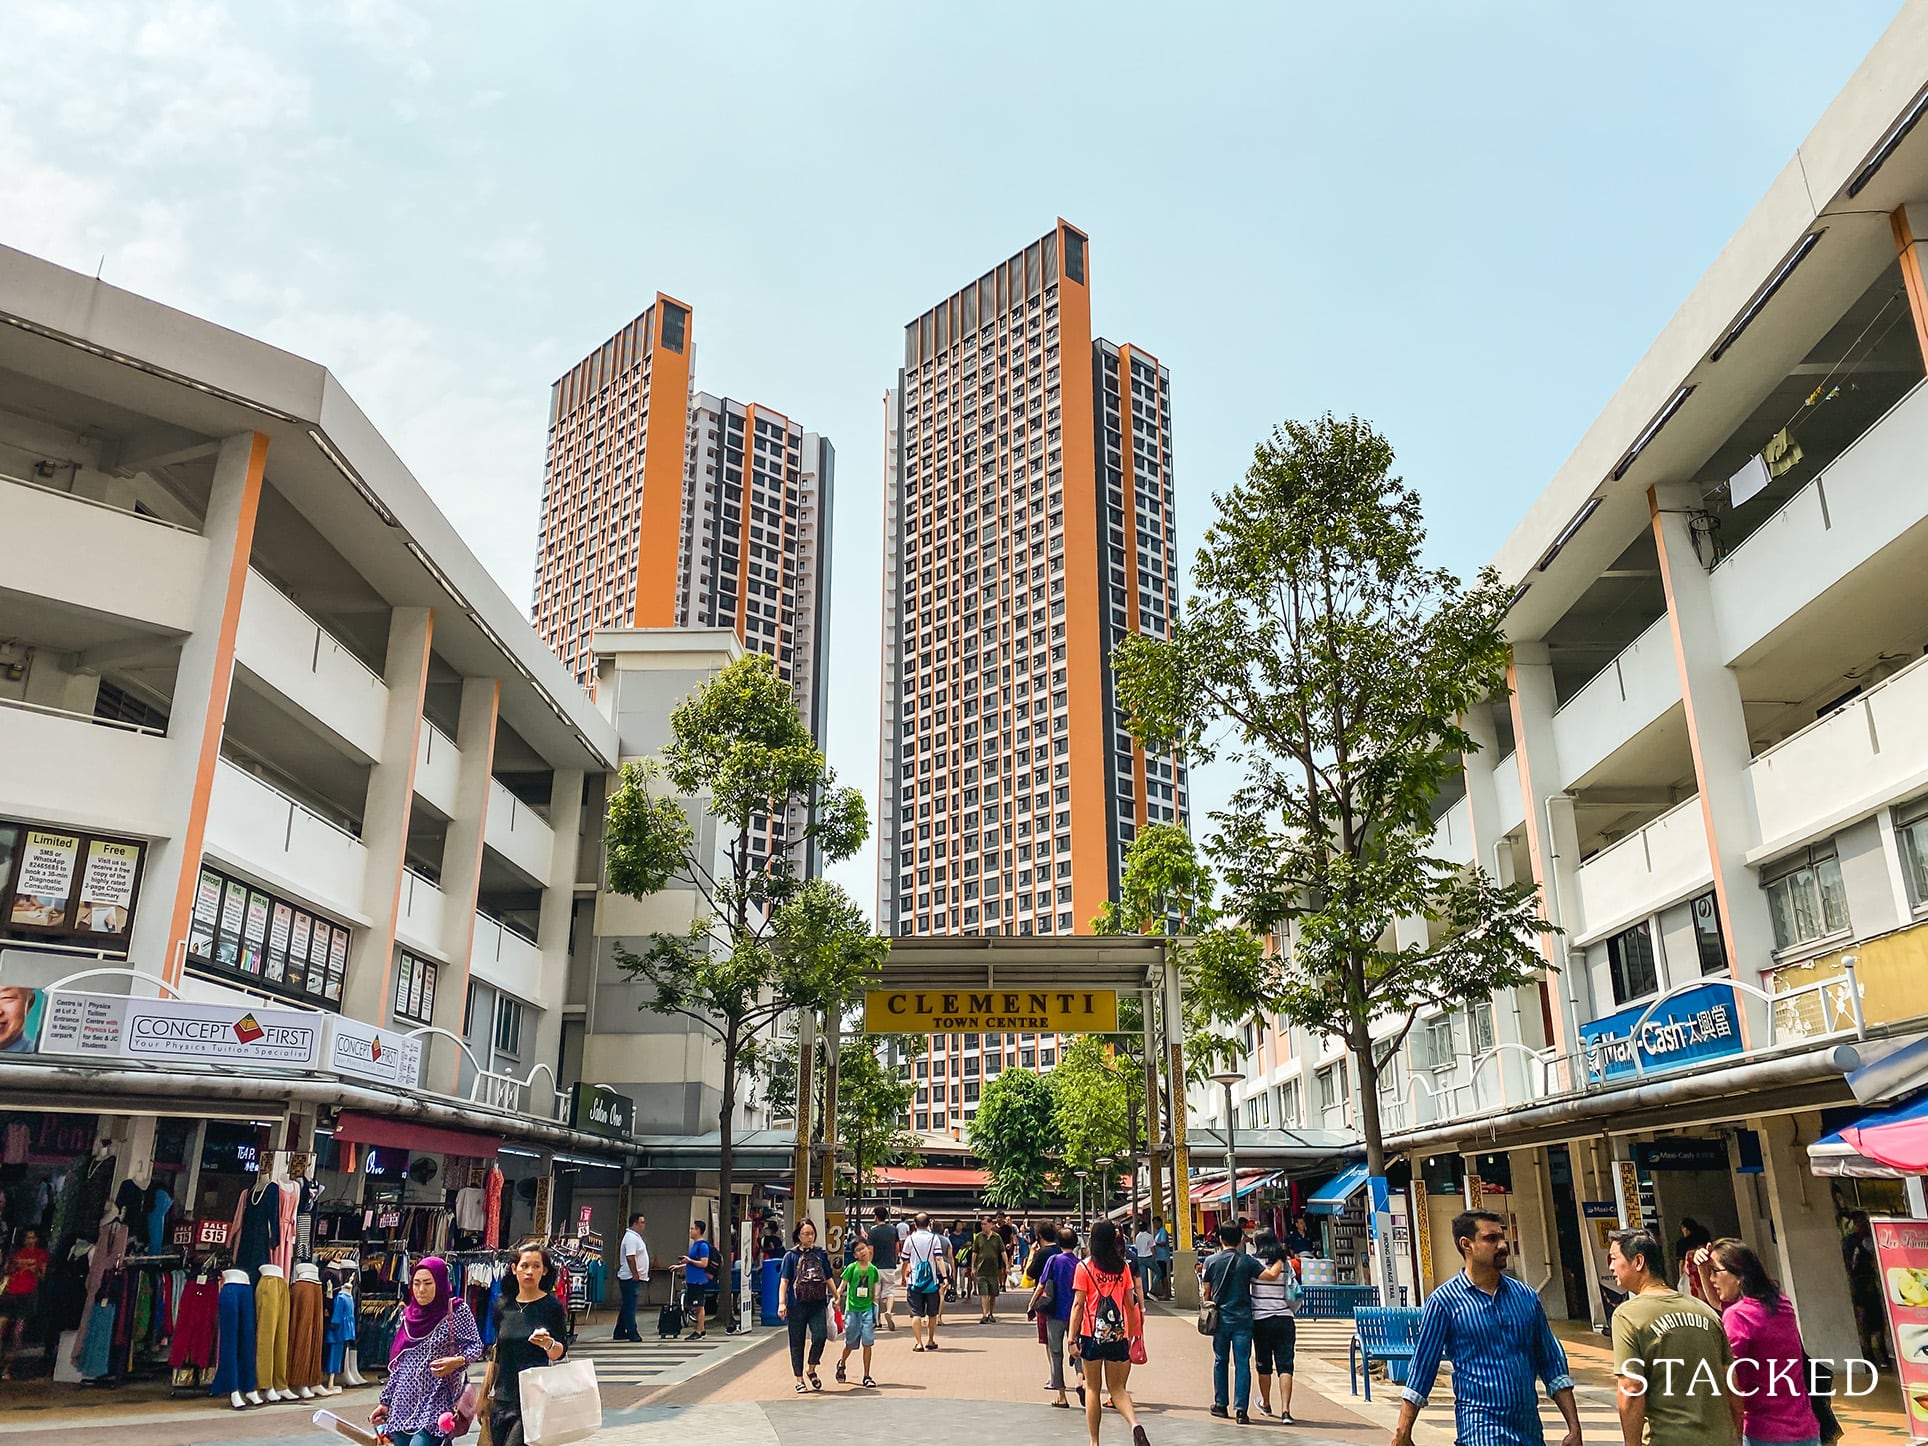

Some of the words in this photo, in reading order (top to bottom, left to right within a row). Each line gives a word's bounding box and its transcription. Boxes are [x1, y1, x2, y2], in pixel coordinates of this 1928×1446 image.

[33, 834, 72, 848] Limited
[103, 844, 126, 855] Free
[28, 876, 62, 885] Diagnostic
[93, 871, 108, 880] copy
[24, 882, 64, 892] Consultation
[106, 885, 130, 894] Chapter
[91, 890, 120, 900] Summary
[888, 994, 1094, 1014] CLEMENTI
[58, 1024, 77, 1032] facing
[933, 1017, 979, 1028] TOWN
[986, 1017, 1048, 1028] CENTRE
[137, 1018, 230, 1040] CONCEPT
[266, 1028, 309, 1046] FIRST
[134, 1039, 159, 1048] Your
[165, 1041, 206, 1051] Physics
[212, 1044, 249, 1053] Tuition
[255, 1047, 307, 1058] Specialist
[337, 1036, 370, 1057] CONCEPT
[381, 1048, 397, 1065] FIRST
[590, 1097, 608, 1124] Salon
[609, 1103, 622, 1127] One
[203, 1222, 228, 1230] SALE
[175, 1232, 190, 1243] $15
[204, 1230, 224, 1242] $15
[827, 1225, 843, 1253] 3
[1382, 1232, 1391, 1256] JURONG
[1385, 1256, 1394, 1283] HERITAGE
[1650, 1311, 1709, 1338] AMBITIOUS
